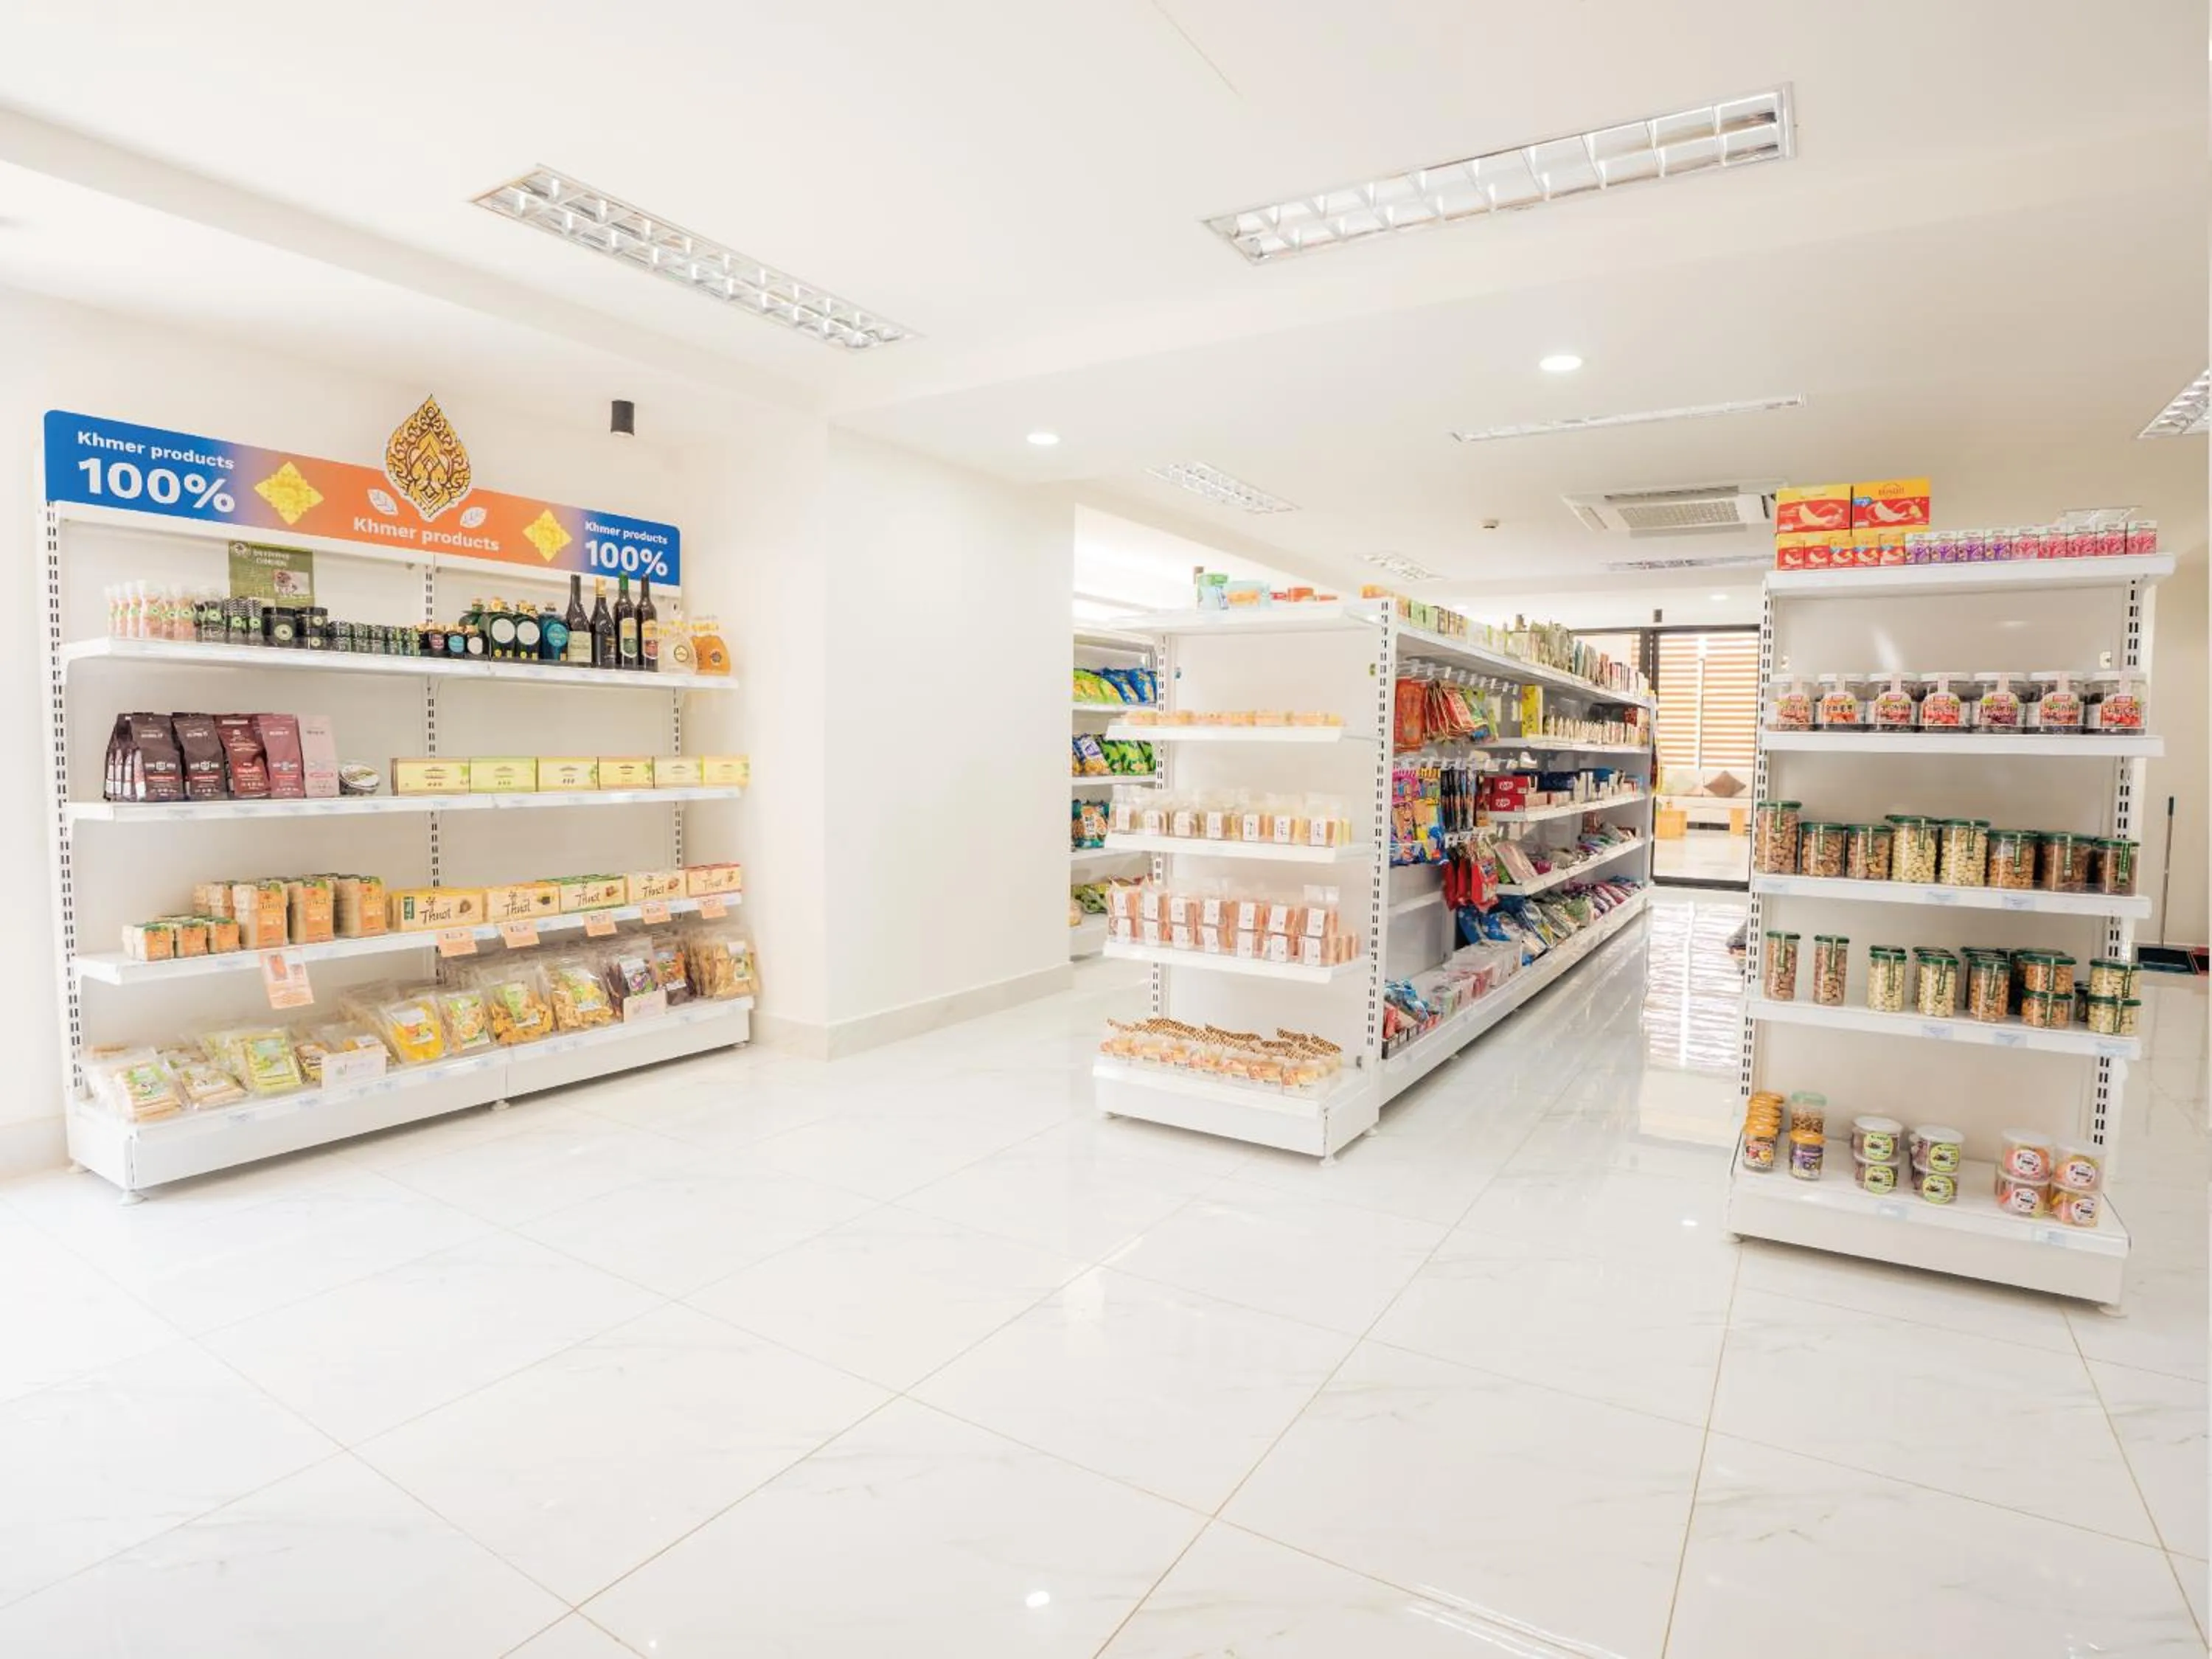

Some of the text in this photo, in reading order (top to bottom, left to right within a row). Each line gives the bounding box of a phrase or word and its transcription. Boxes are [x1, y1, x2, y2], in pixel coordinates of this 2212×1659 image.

[77, 431, 235, 470] Khmer products
[78, 458, 235, 512] 100%
[354, 517, 499, 552] Khmer products
[585, 521, 668, 545] Khmer products
[585, 540, 668, 576] 100%
